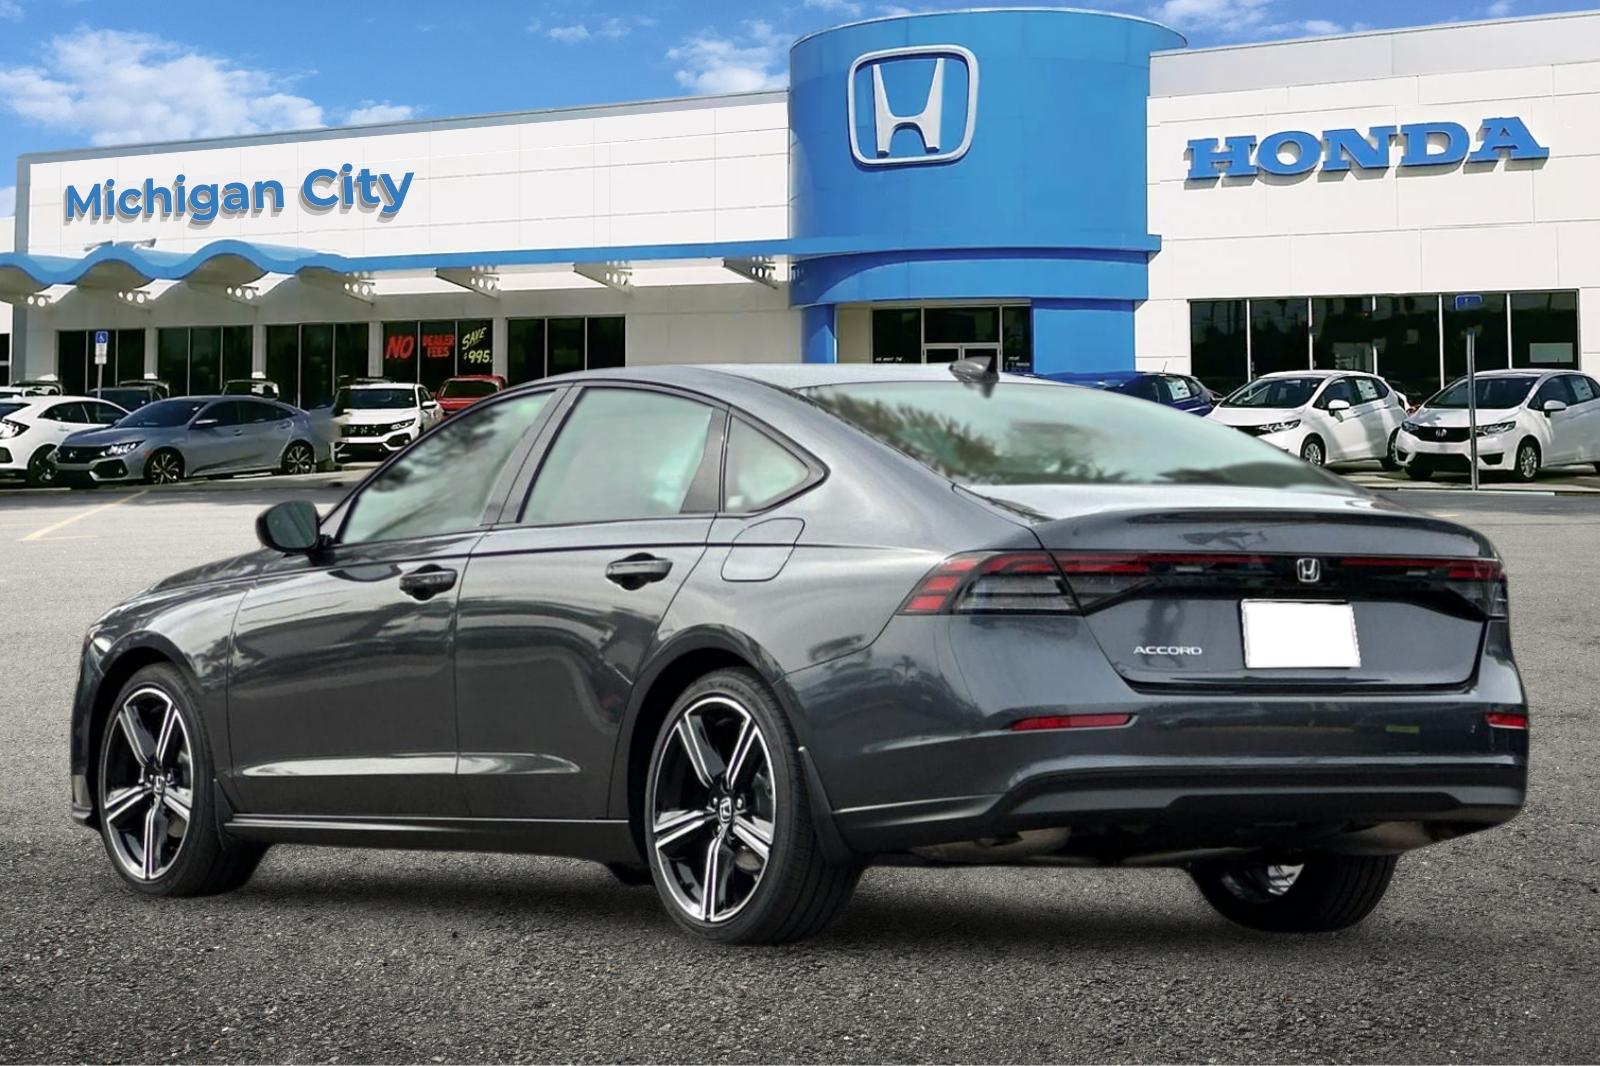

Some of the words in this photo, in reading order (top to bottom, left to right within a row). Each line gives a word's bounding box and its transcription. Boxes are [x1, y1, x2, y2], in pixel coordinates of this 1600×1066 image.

[1185, 116, 1550, 182] HONDA
[66, 173, 285, 223] Michigan
[302, 162, 415, 216] City
[385, 335, 415, 359] NO
[461, 326, 487, 350] SAVE
[1133, 646, 1203, 656] ACCORD
